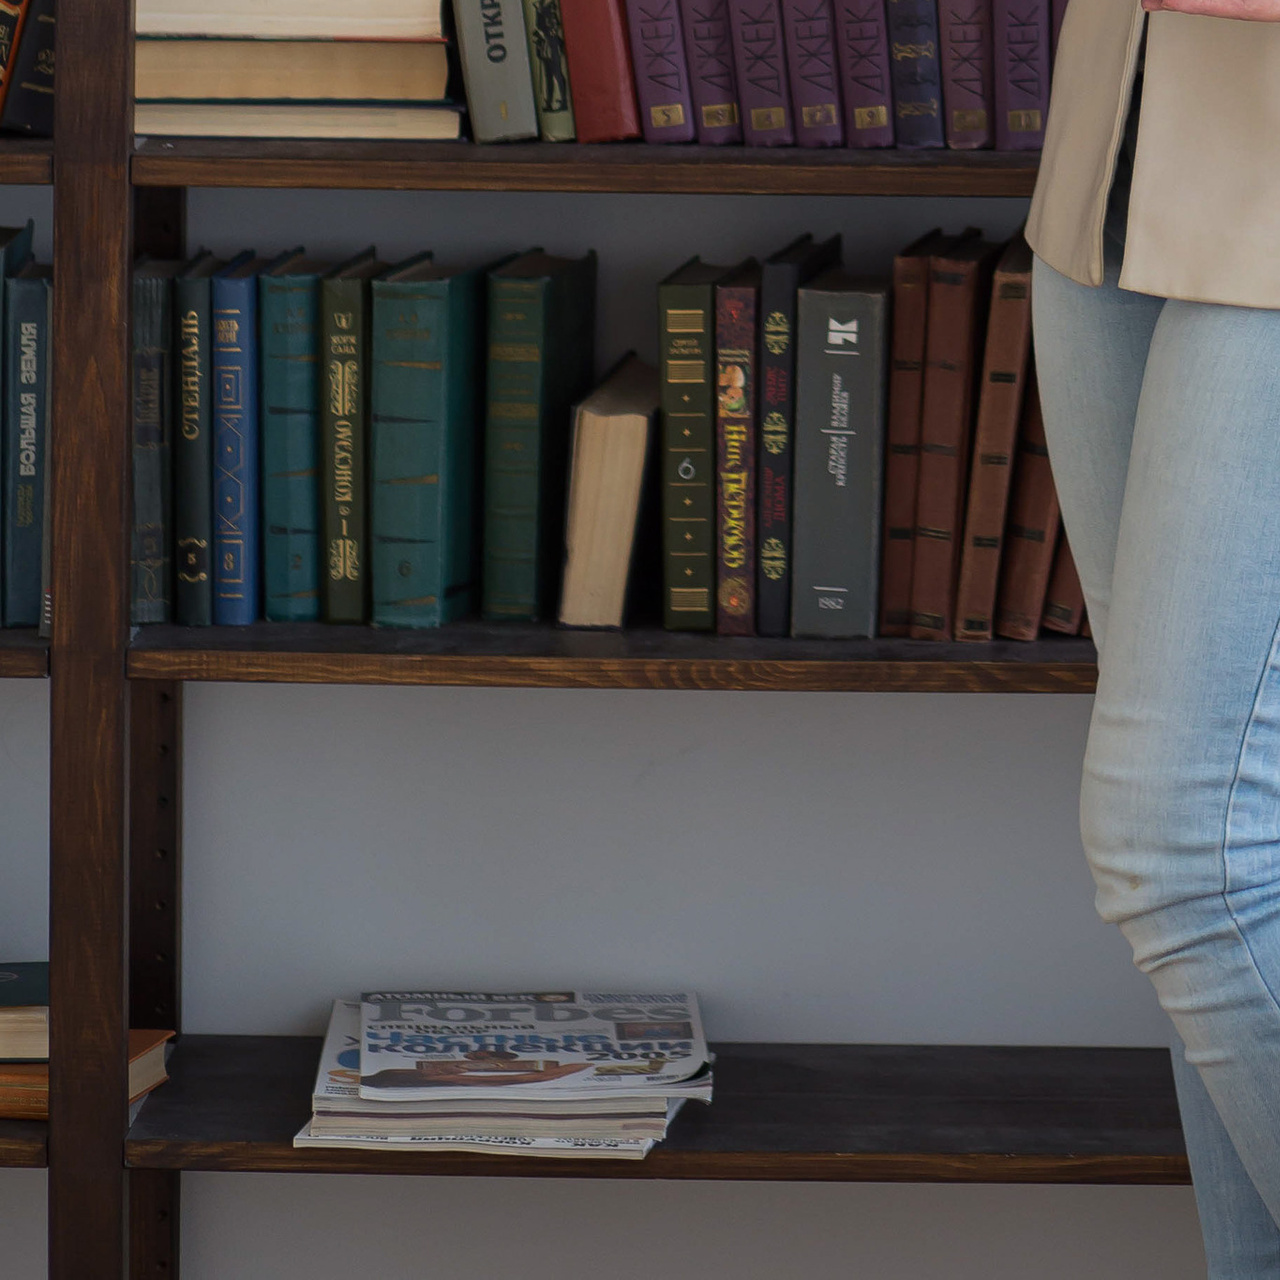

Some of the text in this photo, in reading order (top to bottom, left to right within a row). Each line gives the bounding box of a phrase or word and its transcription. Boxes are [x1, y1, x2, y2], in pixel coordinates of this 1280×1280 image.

[793, 0, 835, 96] ДЖЕК
[181, 309, 201, 441] СТЕНДАЛЬ
[677, 458, 697, 479] 6
[366, 1002, 692, 1022] Forbes
[586, 1051, 692, 1060] 2005
